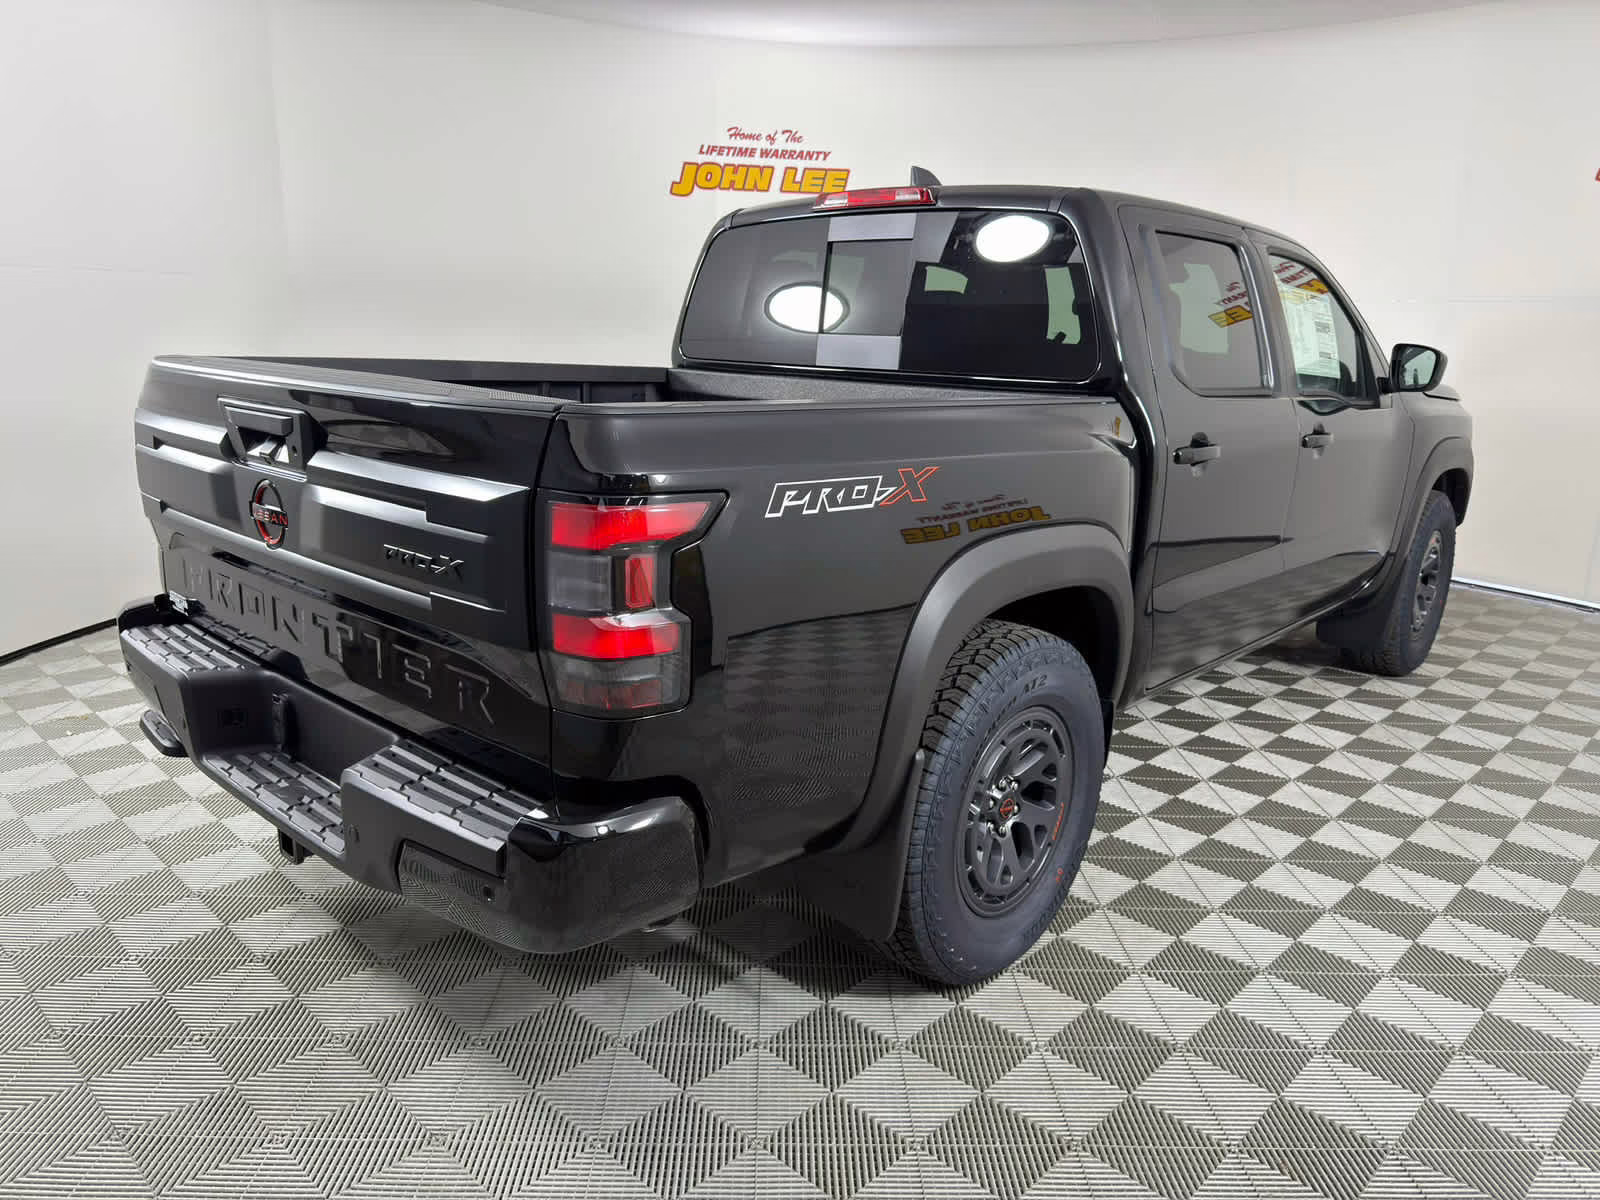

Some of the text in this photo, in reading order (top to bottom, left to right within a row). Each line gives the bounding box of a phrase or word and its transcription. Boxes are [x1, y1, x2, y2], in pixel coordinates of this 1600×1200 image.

[727, 126, 804, 145] Home of The
[698, 144, 832, 162] LIFETIME WARRANTY
[670, 161, 851, 197] JOHN LEE
